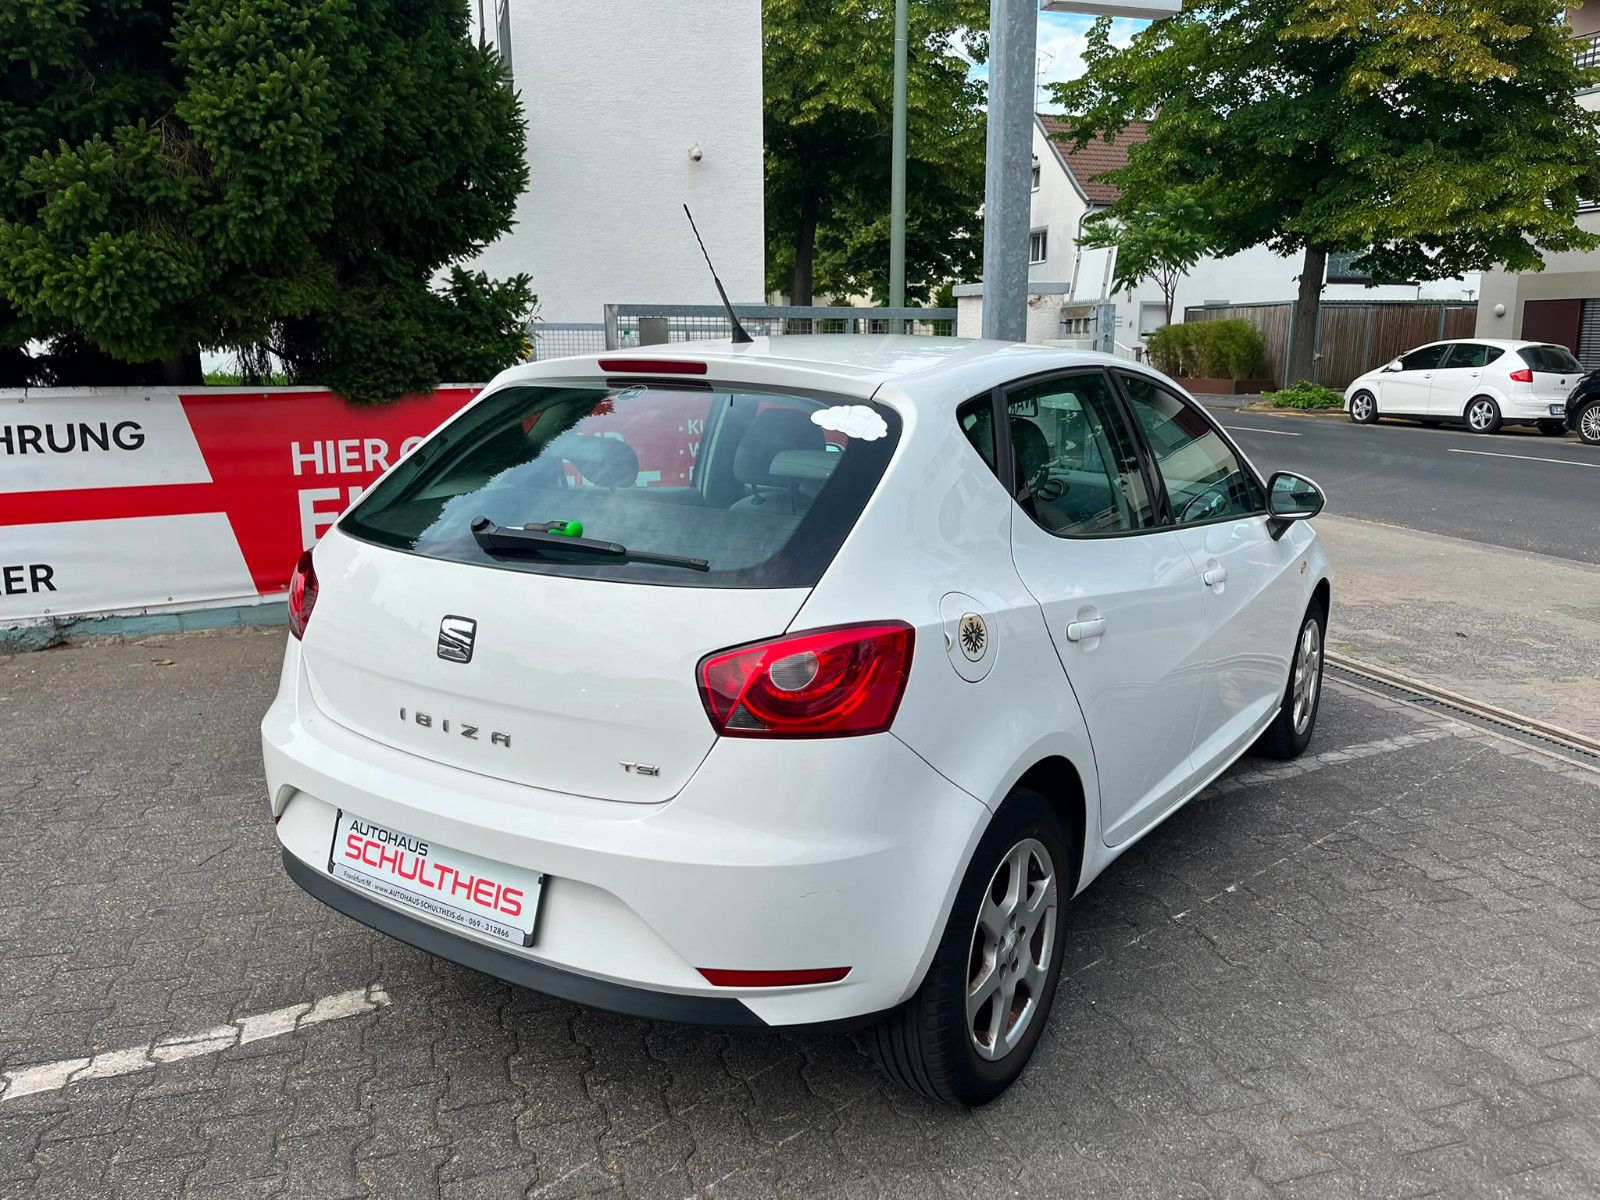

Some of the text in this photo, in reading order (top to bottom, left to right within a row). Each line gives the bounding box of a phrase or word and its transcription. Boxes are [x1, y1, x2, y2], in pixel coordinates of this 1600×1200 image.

[291, 438, 391, 476] HIER
[0, 564, 57, 595] ER
[400, 707, 511, 748] IBIZA
[619, 760, 659, 777] TSI
[350, 820, 429, 857] AUTOHAUS
[345, 834, 524, 917] SCHULTHEIS
[468, 917, 481, 927] 069
[485, 923, 510, 938] 312866
